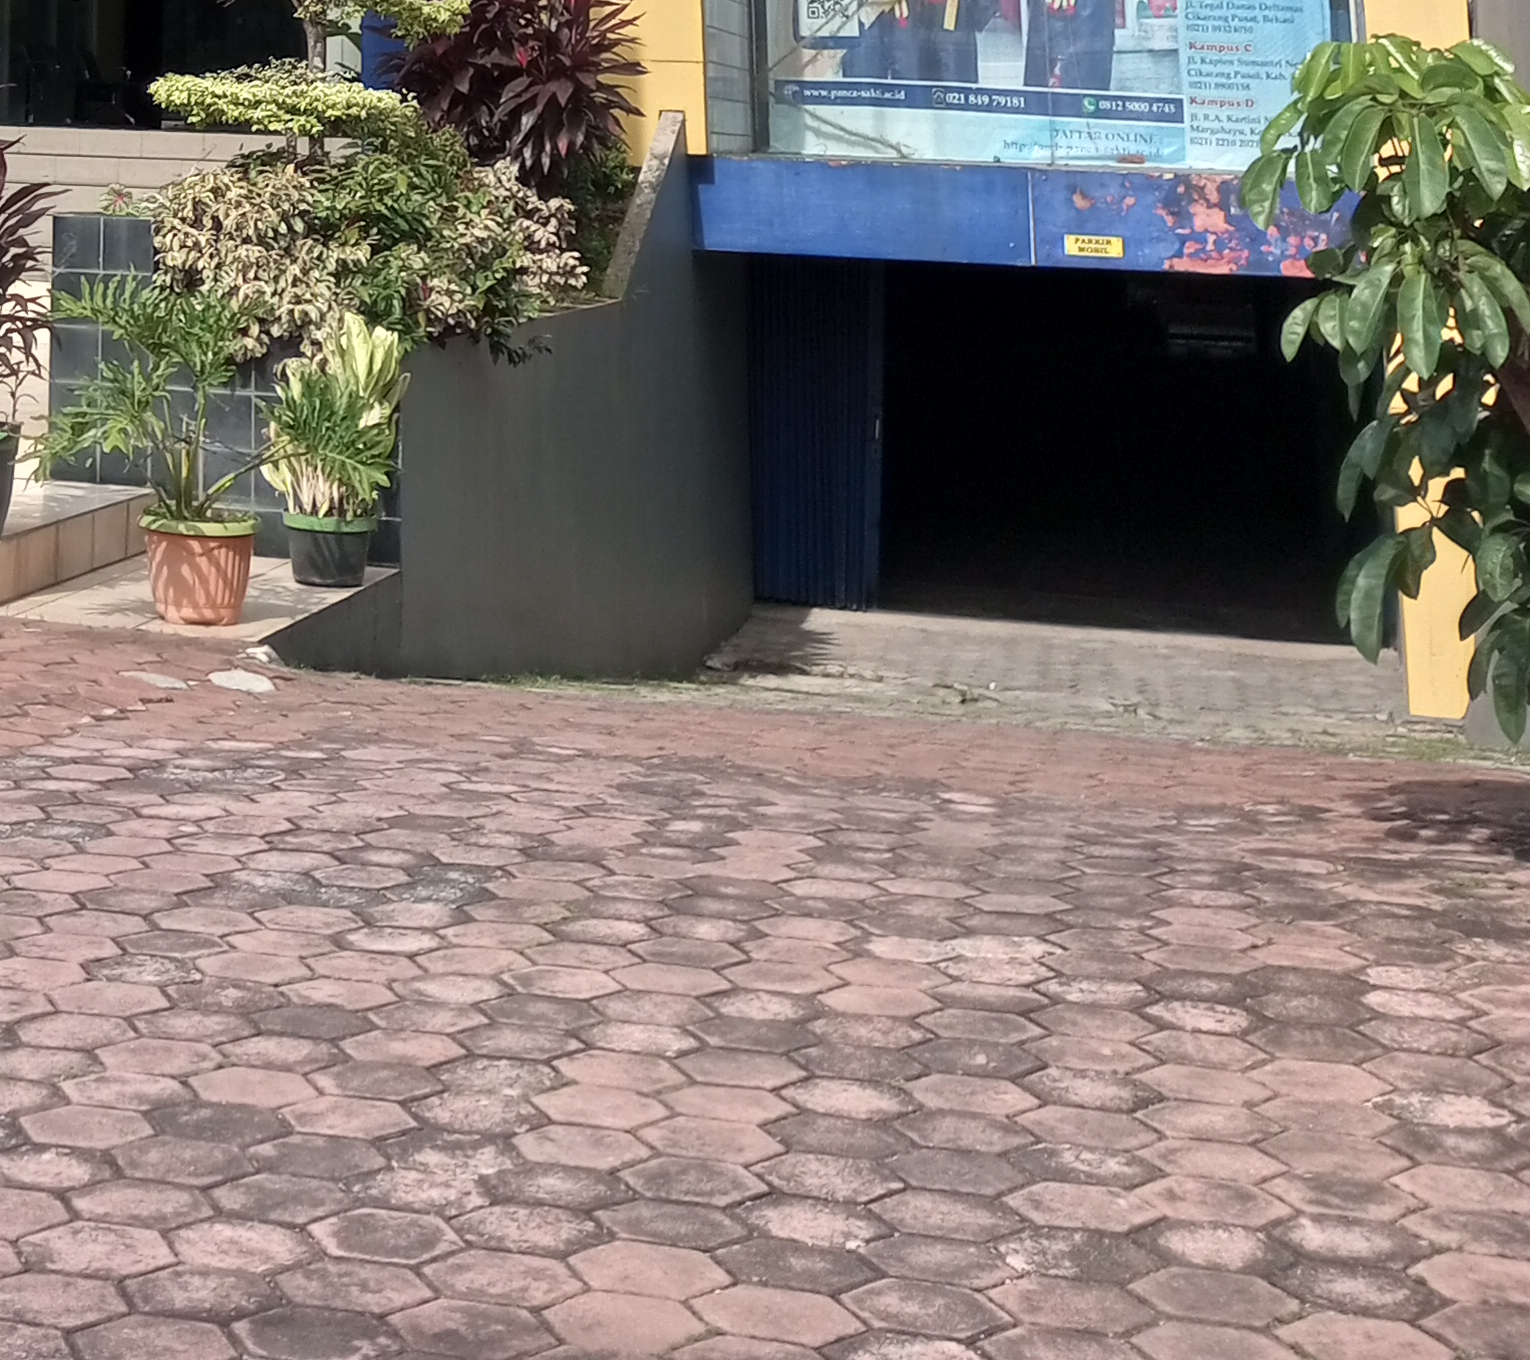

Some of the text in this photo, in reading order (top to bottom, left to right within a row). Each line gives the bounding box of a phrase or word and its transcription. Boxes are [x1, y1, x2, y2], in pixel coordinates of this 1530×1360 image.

[1188, 41, 1252, 53] Kampus C
[945, 93, 965, 105] 021
[992, 95, 1026, 108] 79181
[1189, 96, 1254, 108] Kampus D
[1074, 237, 1112, 246] PARKIR
[1077, 246, 1110, 254] MOBIL
